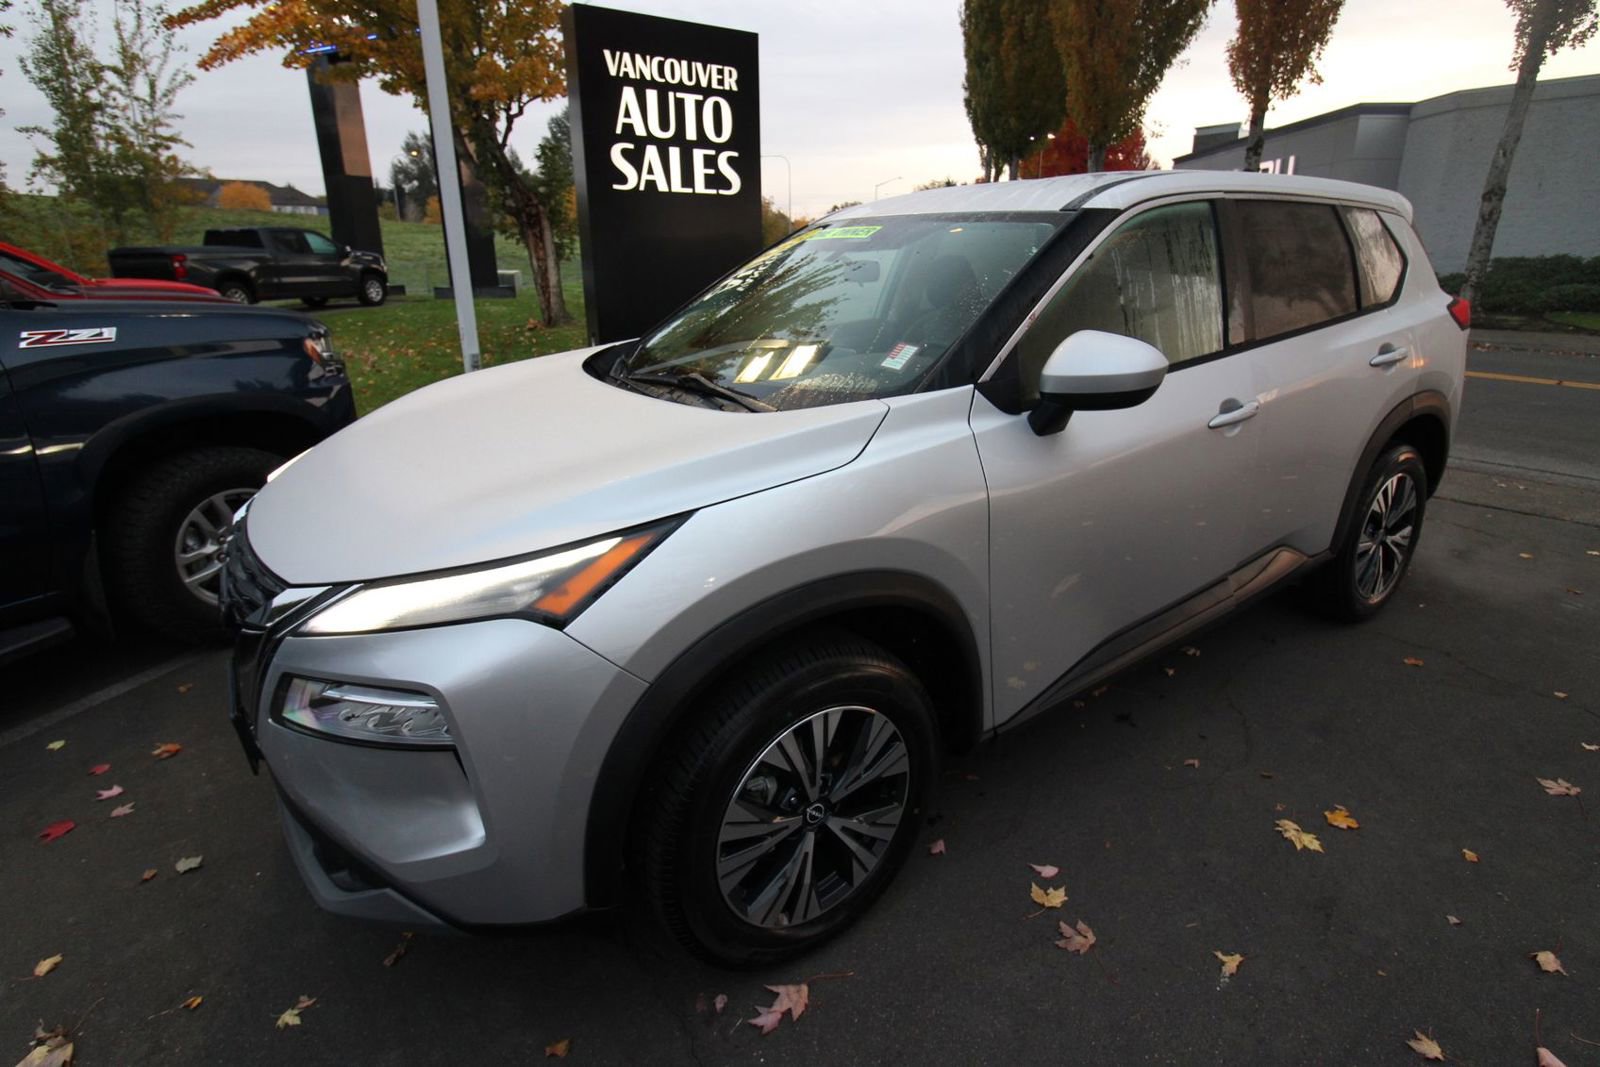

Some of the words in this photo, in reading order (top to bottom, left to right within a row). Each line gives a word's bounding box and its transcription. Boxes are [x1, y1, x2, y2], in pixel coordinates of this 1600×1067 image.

[602, 49, 738, 91] VANCOUVER
[615, 86, 732, 143] AUTO
[610, 142, 741, 195] SALES
